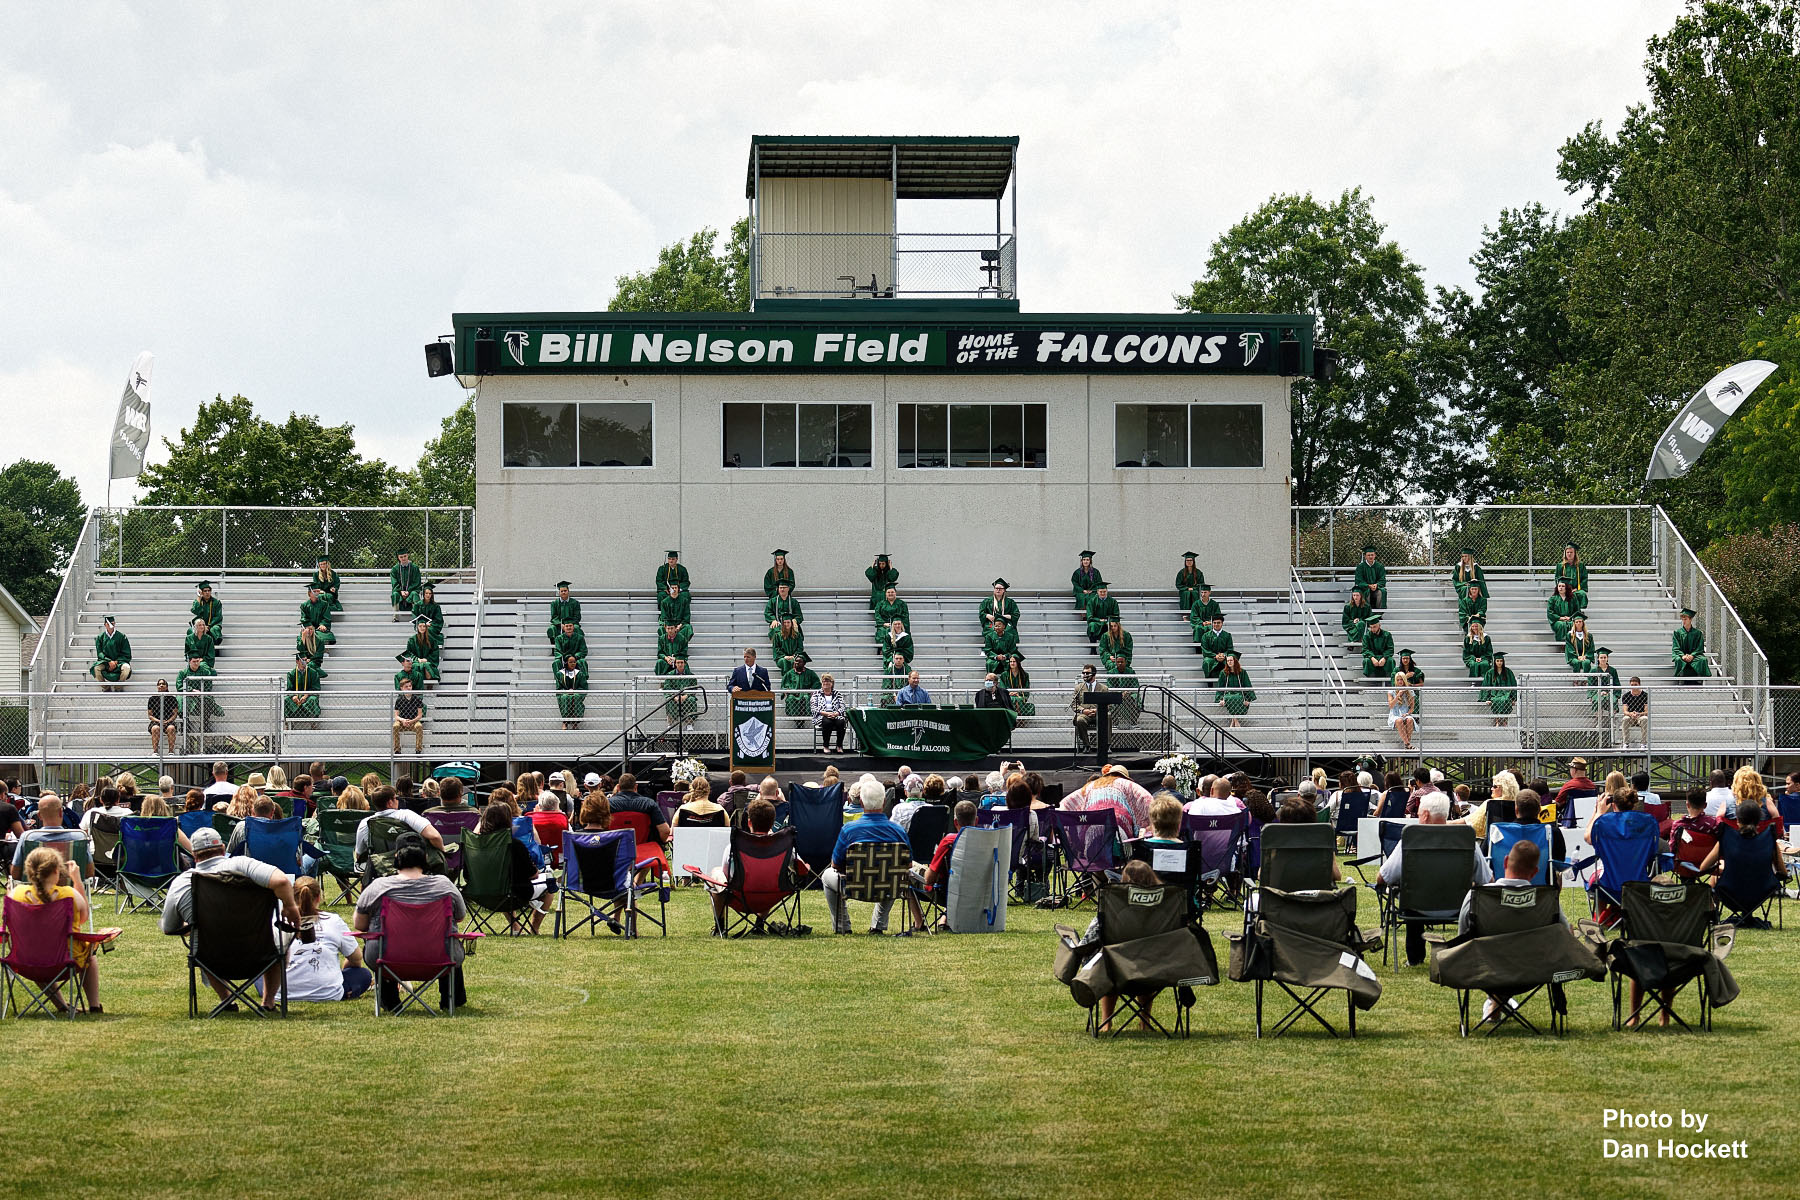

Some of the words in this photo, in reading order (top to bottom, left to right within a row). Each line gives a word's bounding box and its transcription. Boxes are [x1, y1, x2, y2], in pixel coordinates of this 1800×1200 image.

[539, 333, 612, 363] Bill
[630, 333, 794, 363] Nelson
[812, 333, 929, 363] Field
[957, 332, 1015, 350] HOME
[1036, 331, 1228, 364] FALCONS
[956, 350, 982, 364] OF
[985, 346, 1018, 361] THE
[1679, 411, 1715, 444] WB
[1667, 434, 1689, 471] FALCONS
[886, 742, 903, 750] Home
[910, 744, 920, 752] the
[922, 744, 950, 752] FALCONS
[1132, 892, 1160, 903] KENT
[1505, 892, 1533, 904] KENT
[1654, 890, 1683, 900] KENT
